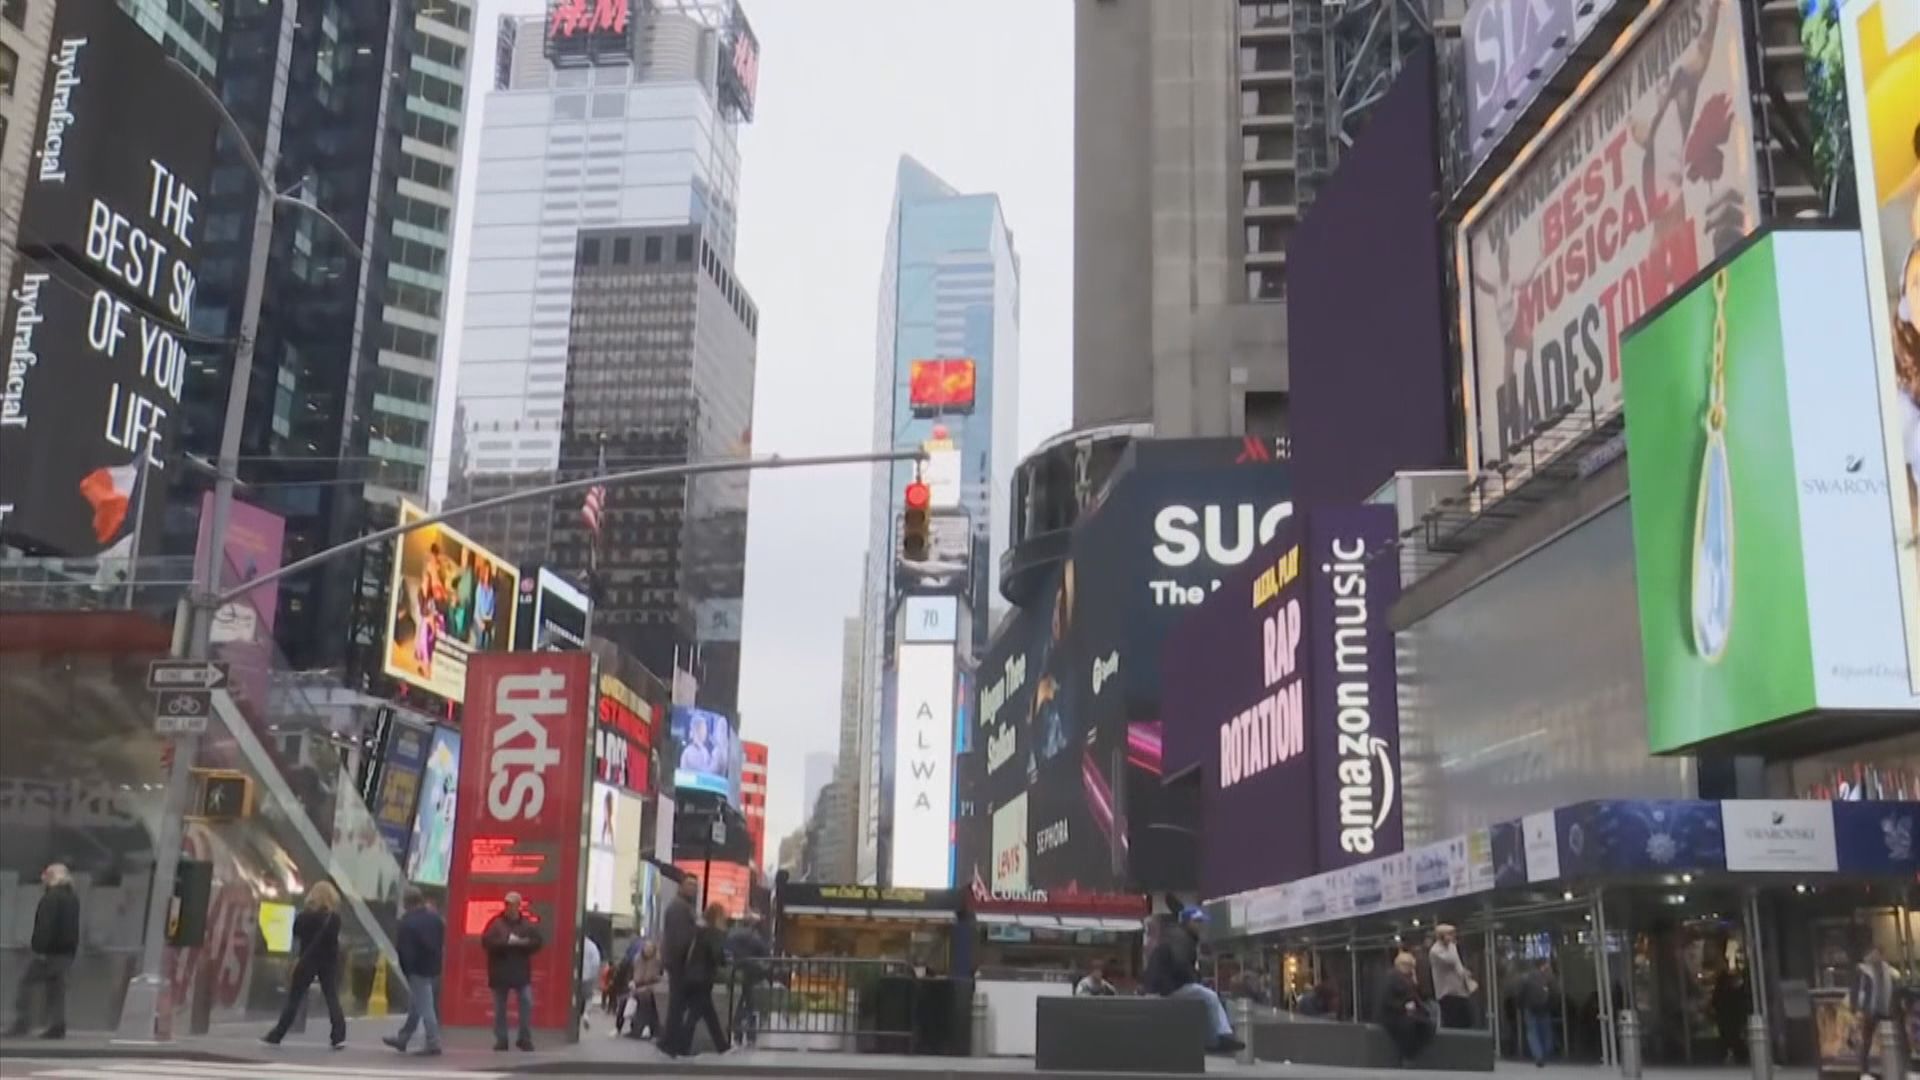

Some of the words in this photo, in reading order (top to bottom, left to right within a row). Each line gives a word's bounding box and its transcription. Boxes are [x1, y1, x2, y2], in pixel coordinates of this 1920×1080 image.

[37, 37, 87, 183] hydrafacial
[86, 198, 166, 298] BEST
[150, 159, 198, 248] THE
[1541, 126, 1628, 256] BEST
[88, 289, 131, 357] OF
[1515, 190, 1668, 345] MUSICAL
[0, 272, 49, 429] hydrafacial
[105, 382, 166, 471] LIFE
[1149, 580, 1204, 605] The
[1264, 599, 1301, 688] RAP
[1322, 538, 1369, 673] music
[487, 667, 567, 821] tkts
[1221, 679, 1304, 789] ROTATION
[1337, 682, 1377, 854] amazon
